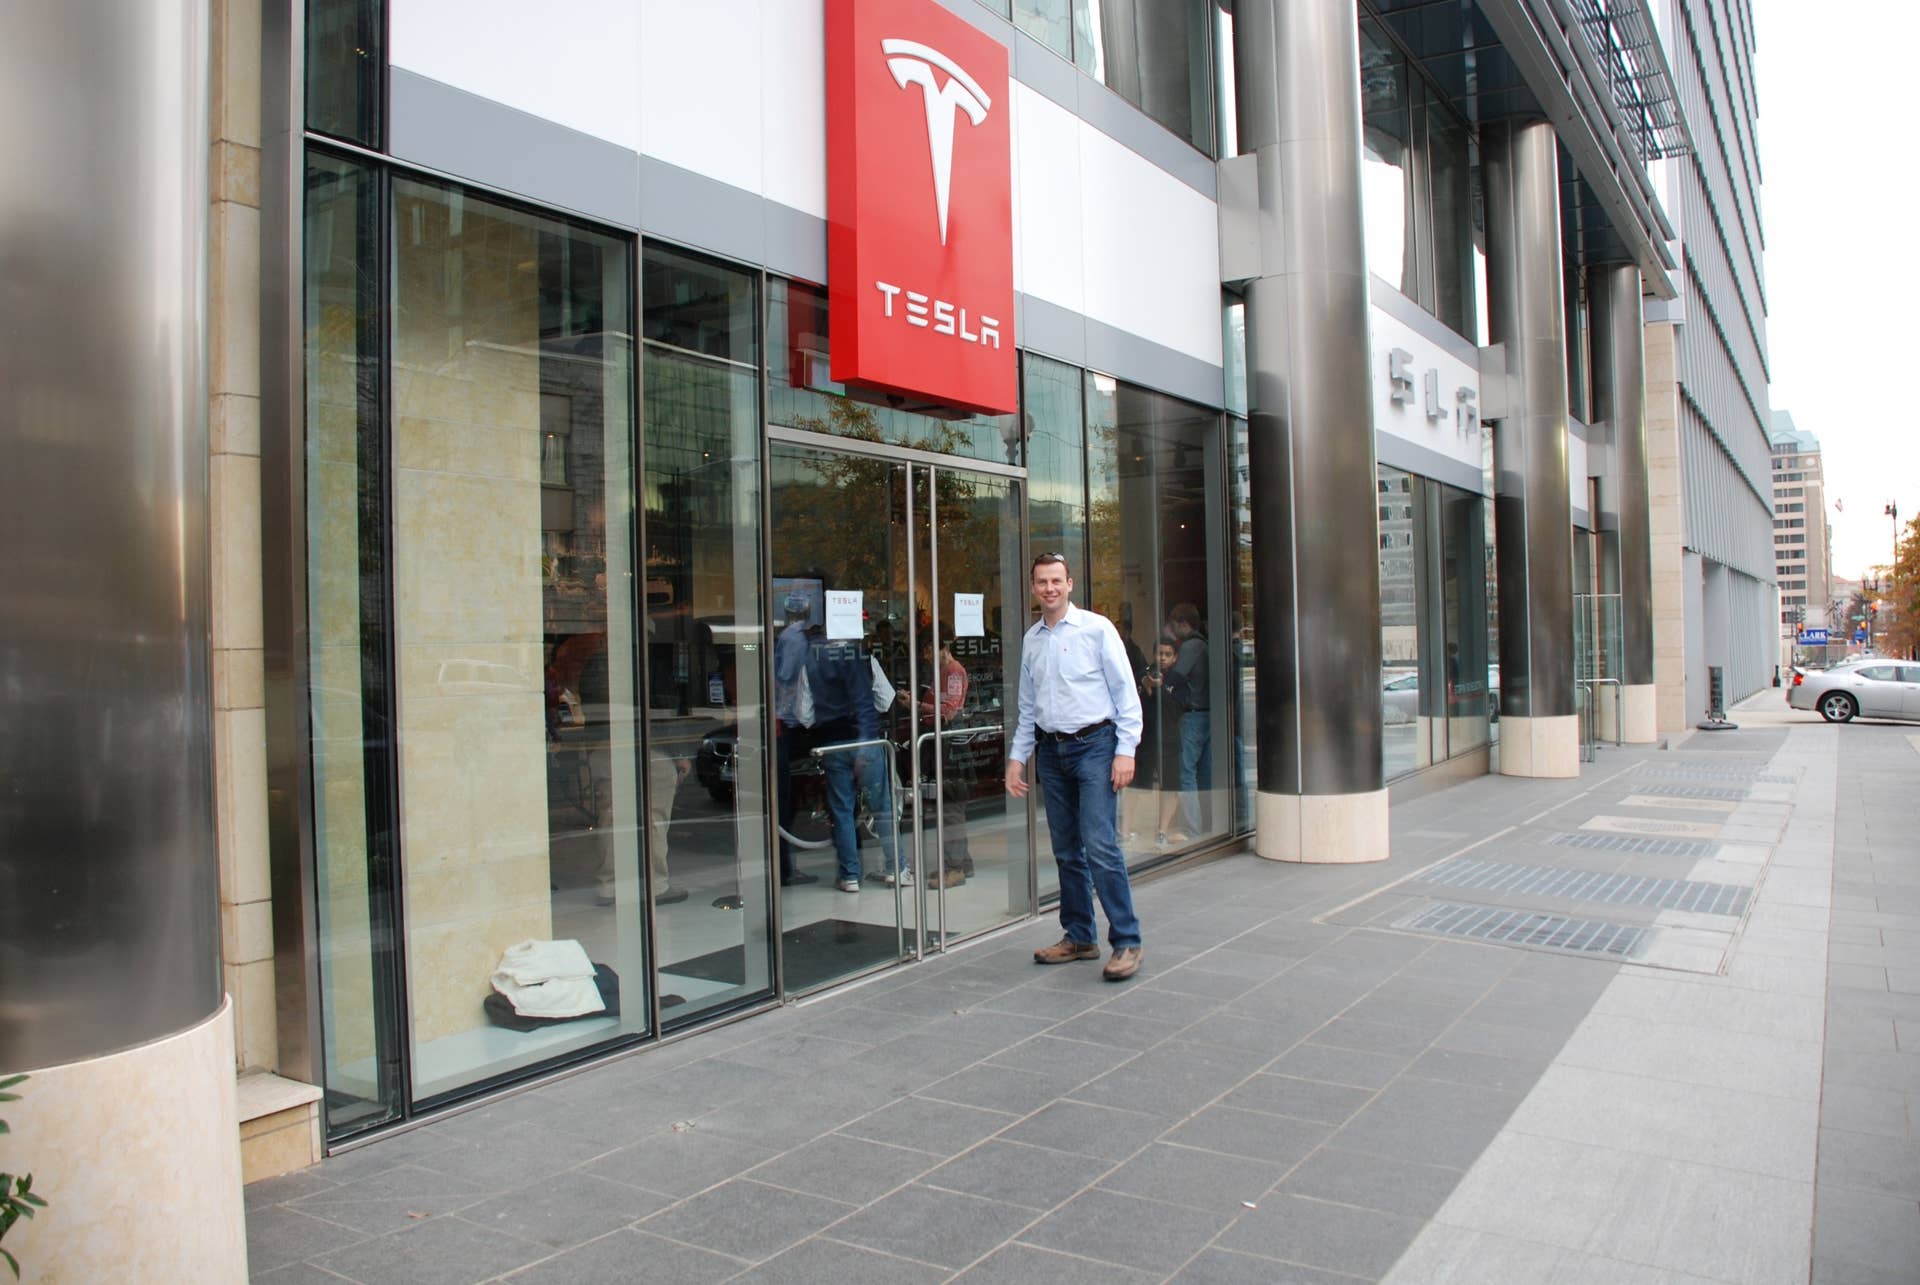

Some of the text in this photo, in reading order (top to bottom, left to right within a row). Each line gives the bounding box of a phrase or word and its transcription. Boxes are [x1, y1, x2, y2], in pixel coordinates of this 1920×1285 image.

[875, 280, 1000, 349] TESLA
[1389, 347, 1477, 434] SLA
[1799, 631, 1826, 640] CLARK
[811, 642, 883, 661] TESLA
[944, 638, 999, 655] TESLA
